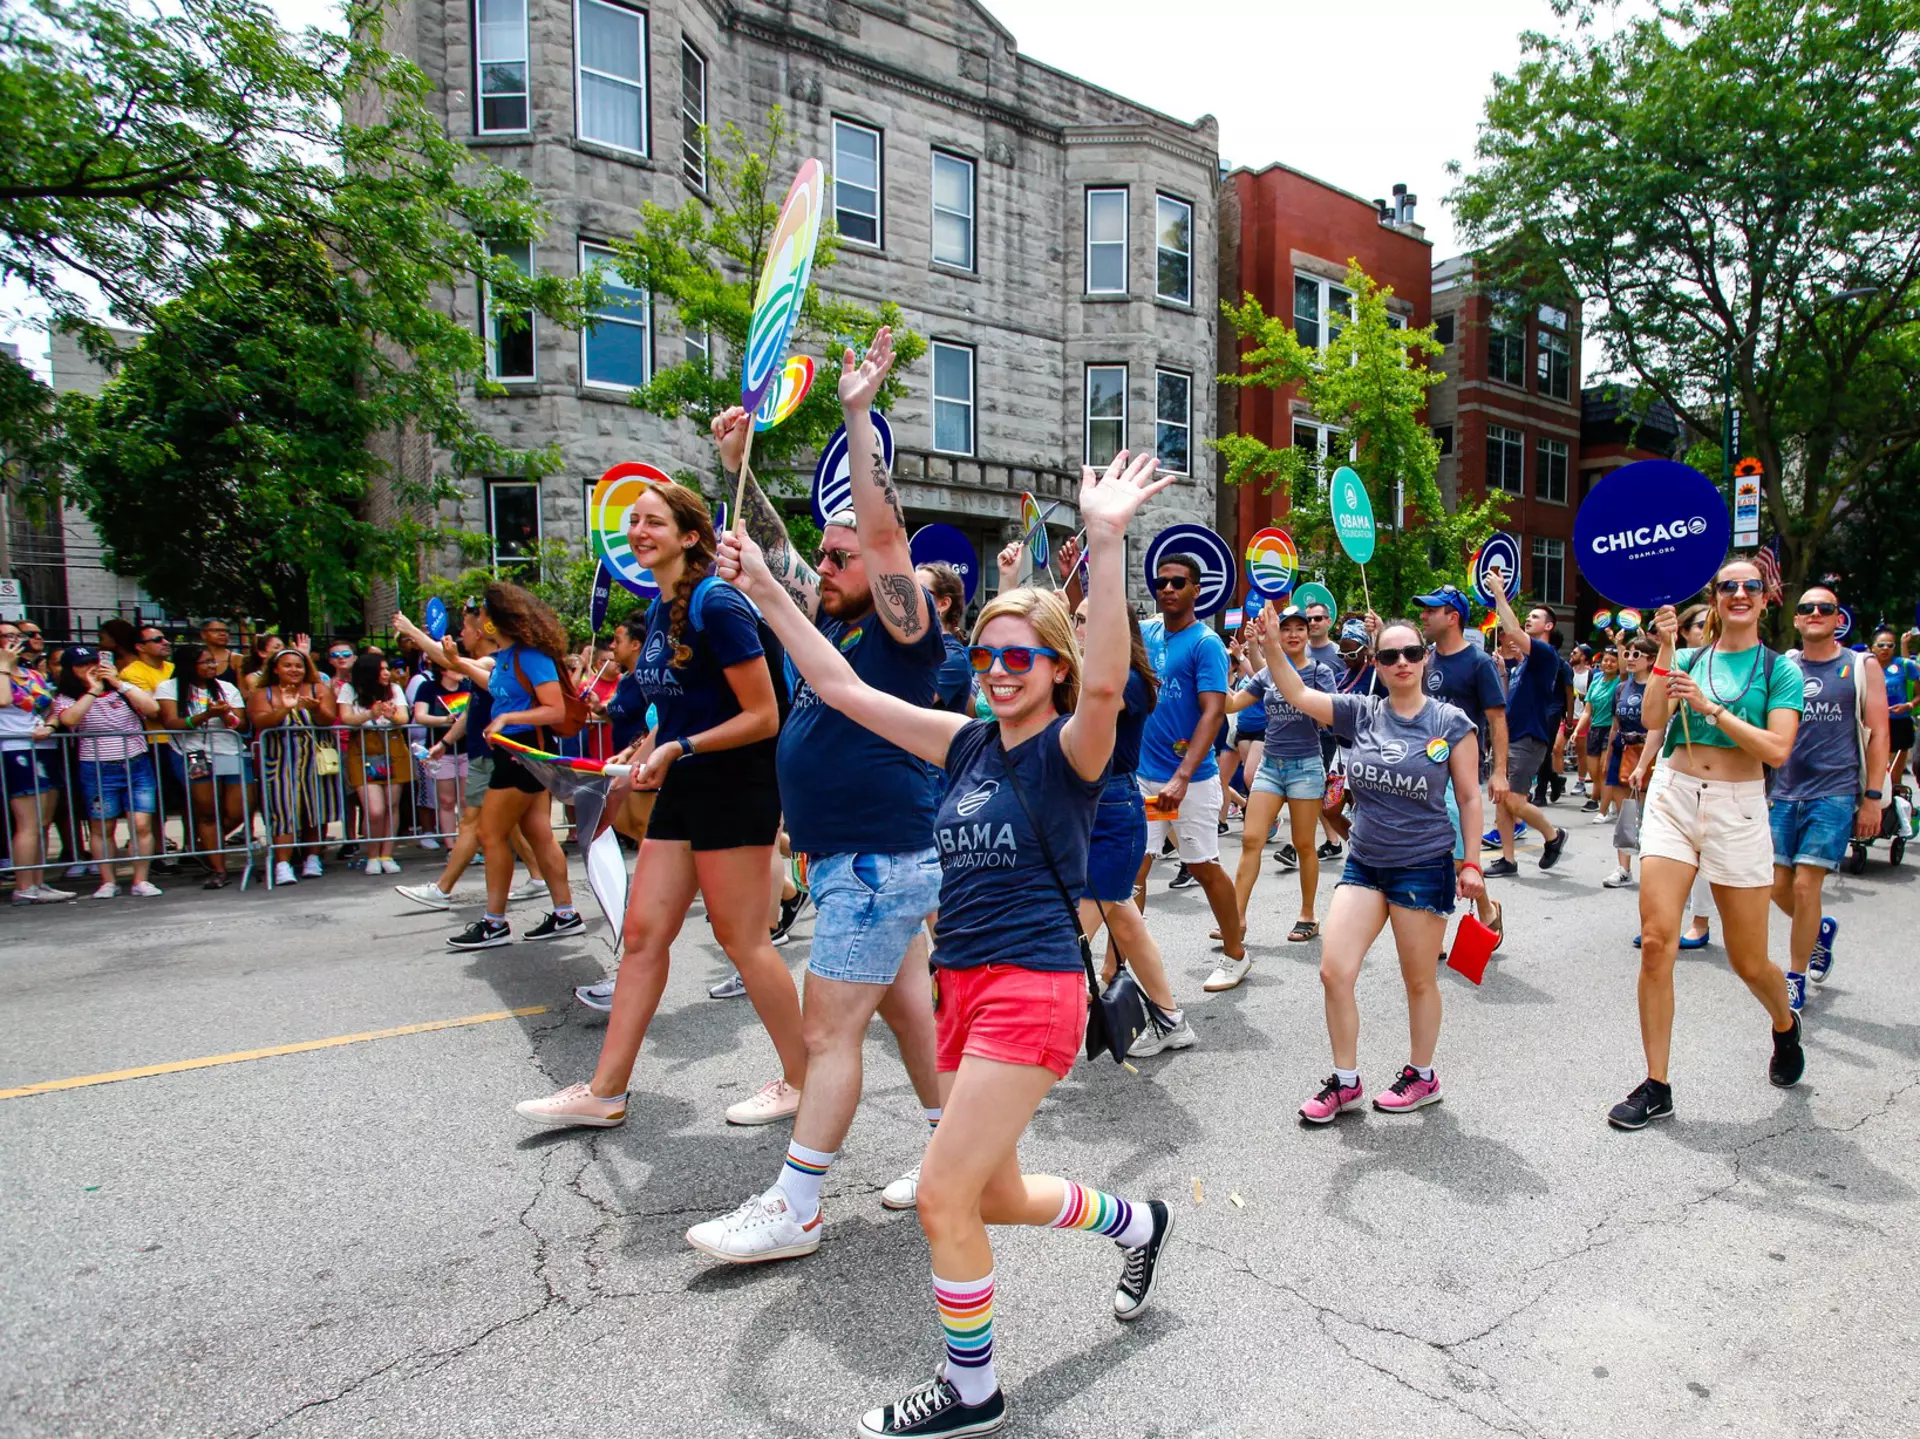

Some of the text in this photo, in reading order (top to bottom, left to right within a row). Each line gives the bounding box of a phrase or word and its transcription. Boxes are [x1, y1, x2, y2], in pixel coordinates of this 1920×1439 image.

[1340, 514, 1371, 529] OBAMA
[1341, 529, 1373, 538] FOUNDATION
[1592, 516, 1707, 554] CHICAGO
[1628, 546, 1675, 560] OBAMA.ORG
[635, 668, 680, 685] BAMA
[1803, 701, 1842, 714] AMA
[1351, 761, 1428, 791] OBAMA
[1350, 777, 1428, 800] FOUNDATION
